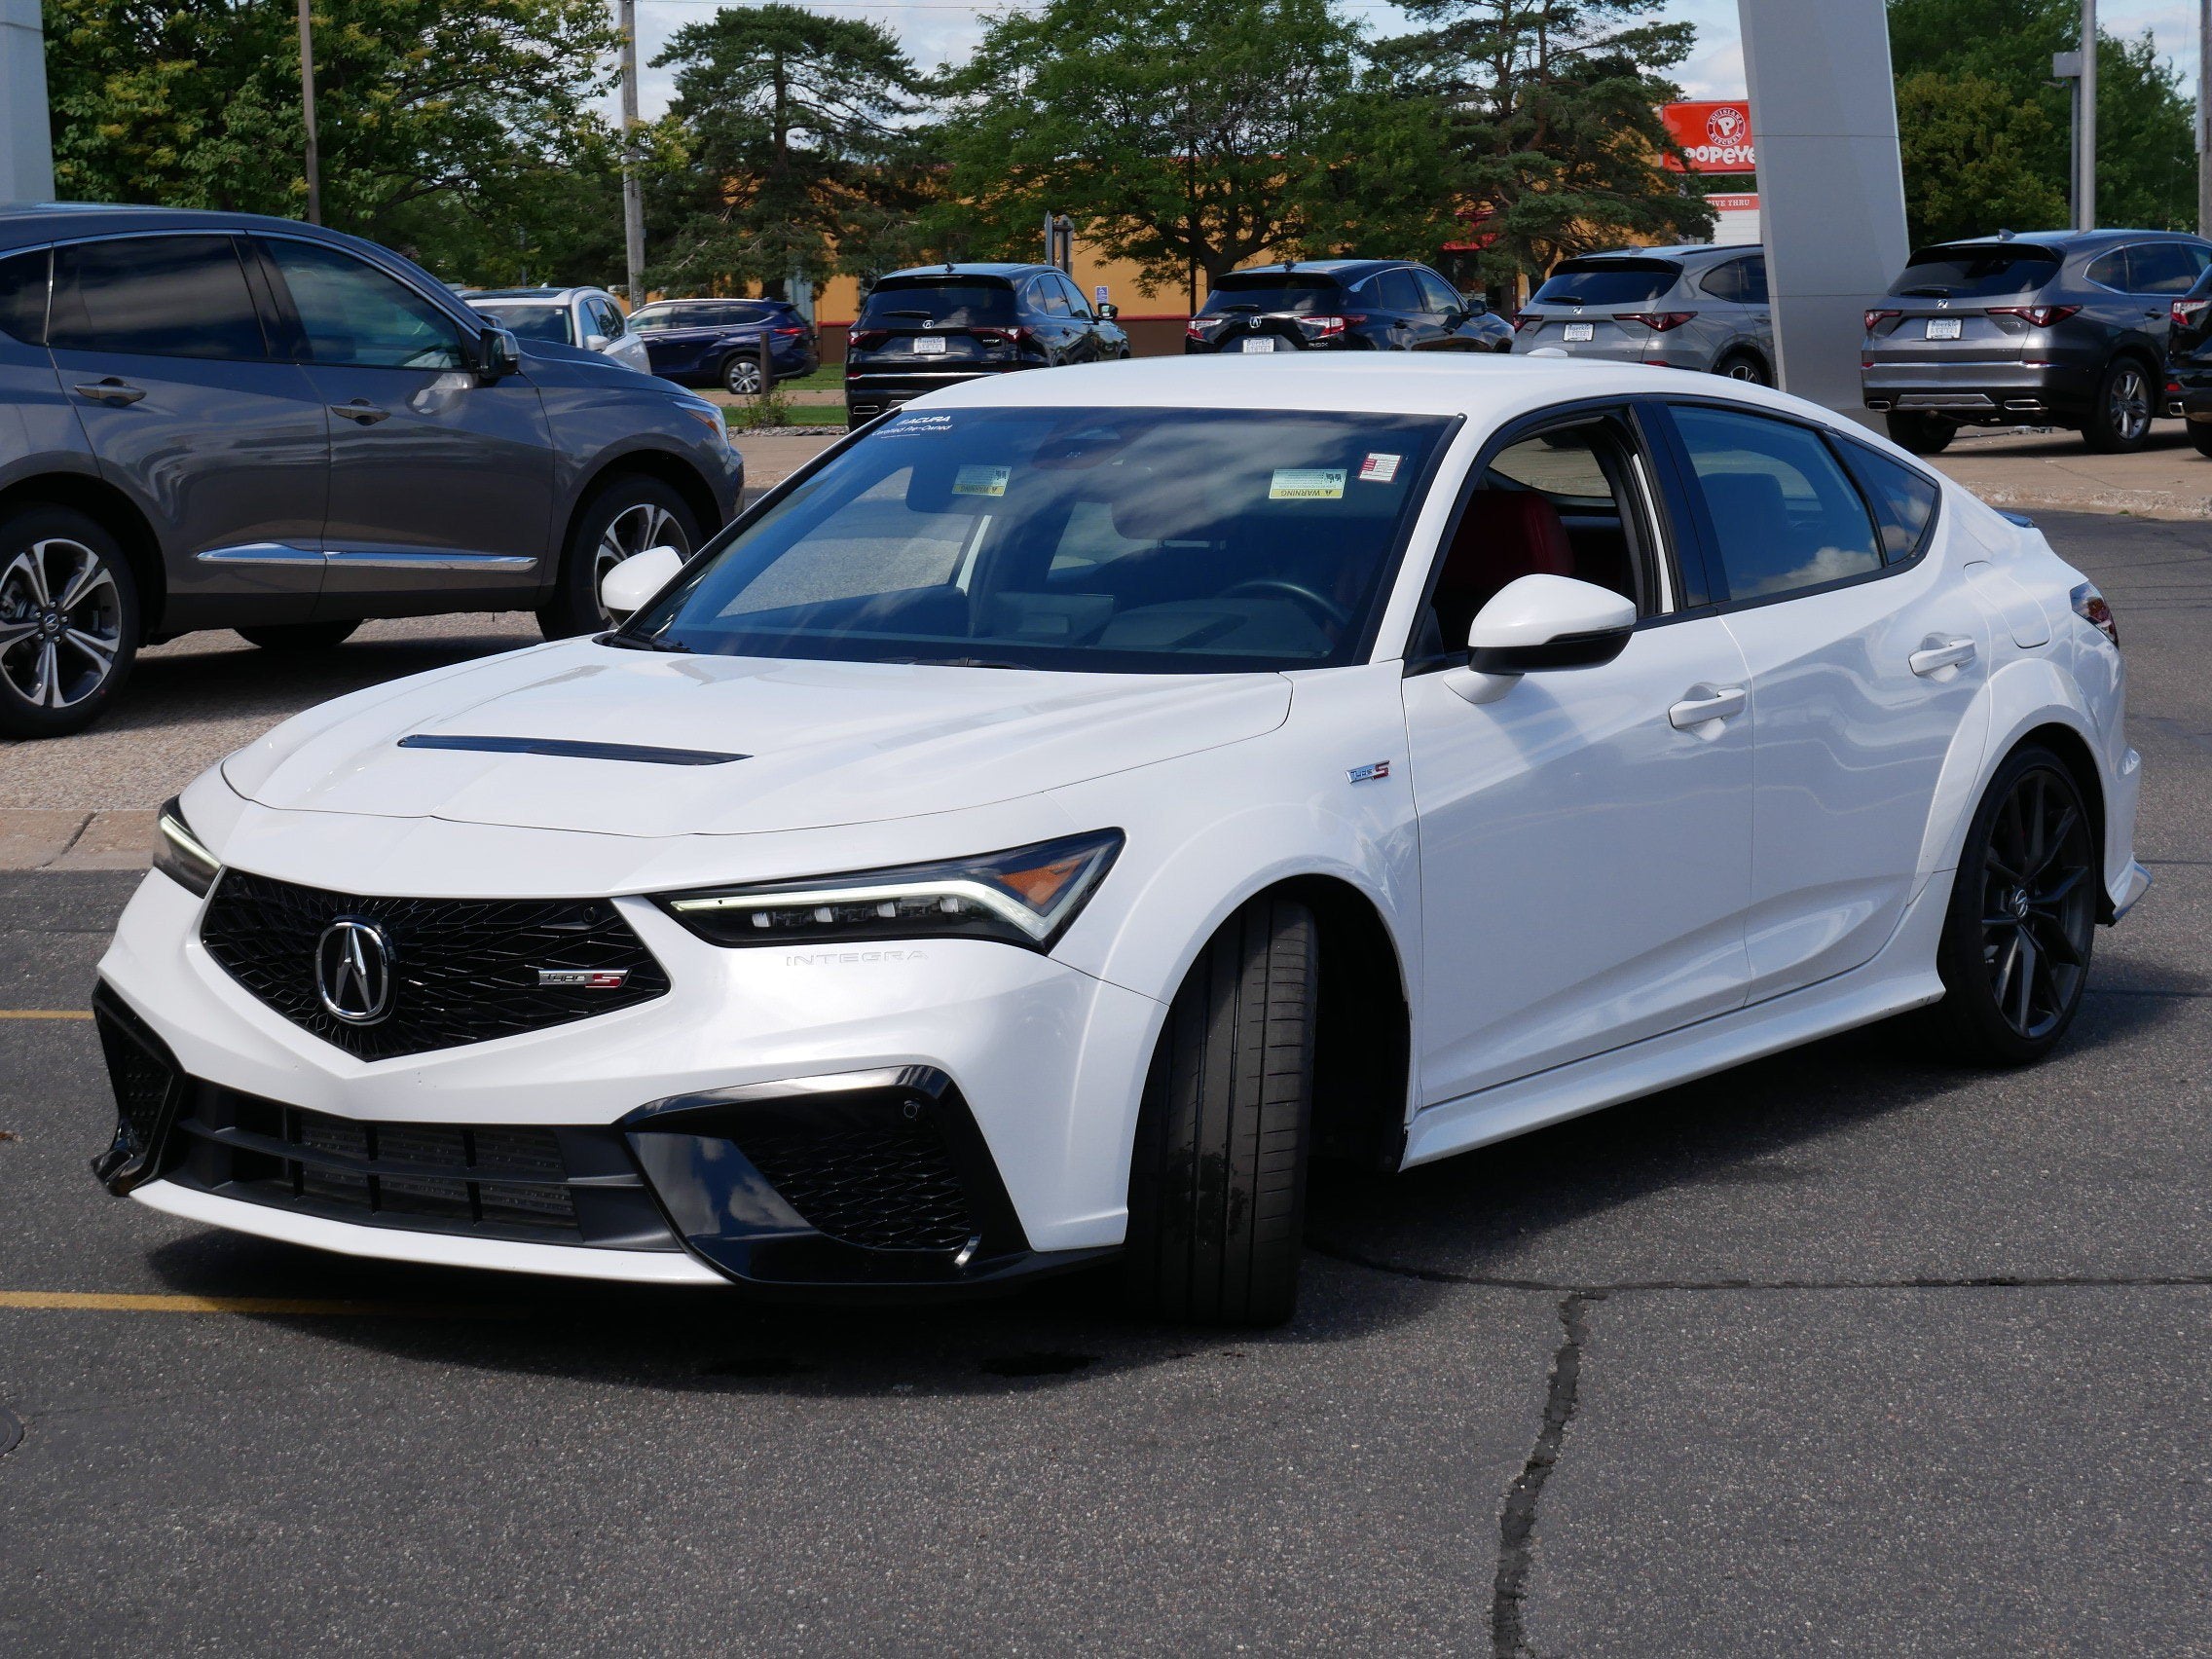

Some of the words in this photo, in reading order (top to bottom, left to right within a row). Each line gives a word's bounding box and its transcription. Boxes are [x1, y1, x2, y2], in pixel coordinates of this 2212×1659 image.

[1717, 117, 1736, 136] P
[906, 416, 951, 425] ACURA
[1373, 760, 1390, 780] S
[786, 950, 929, 967] INTEGRA
[585, 973, 627, 988] S
